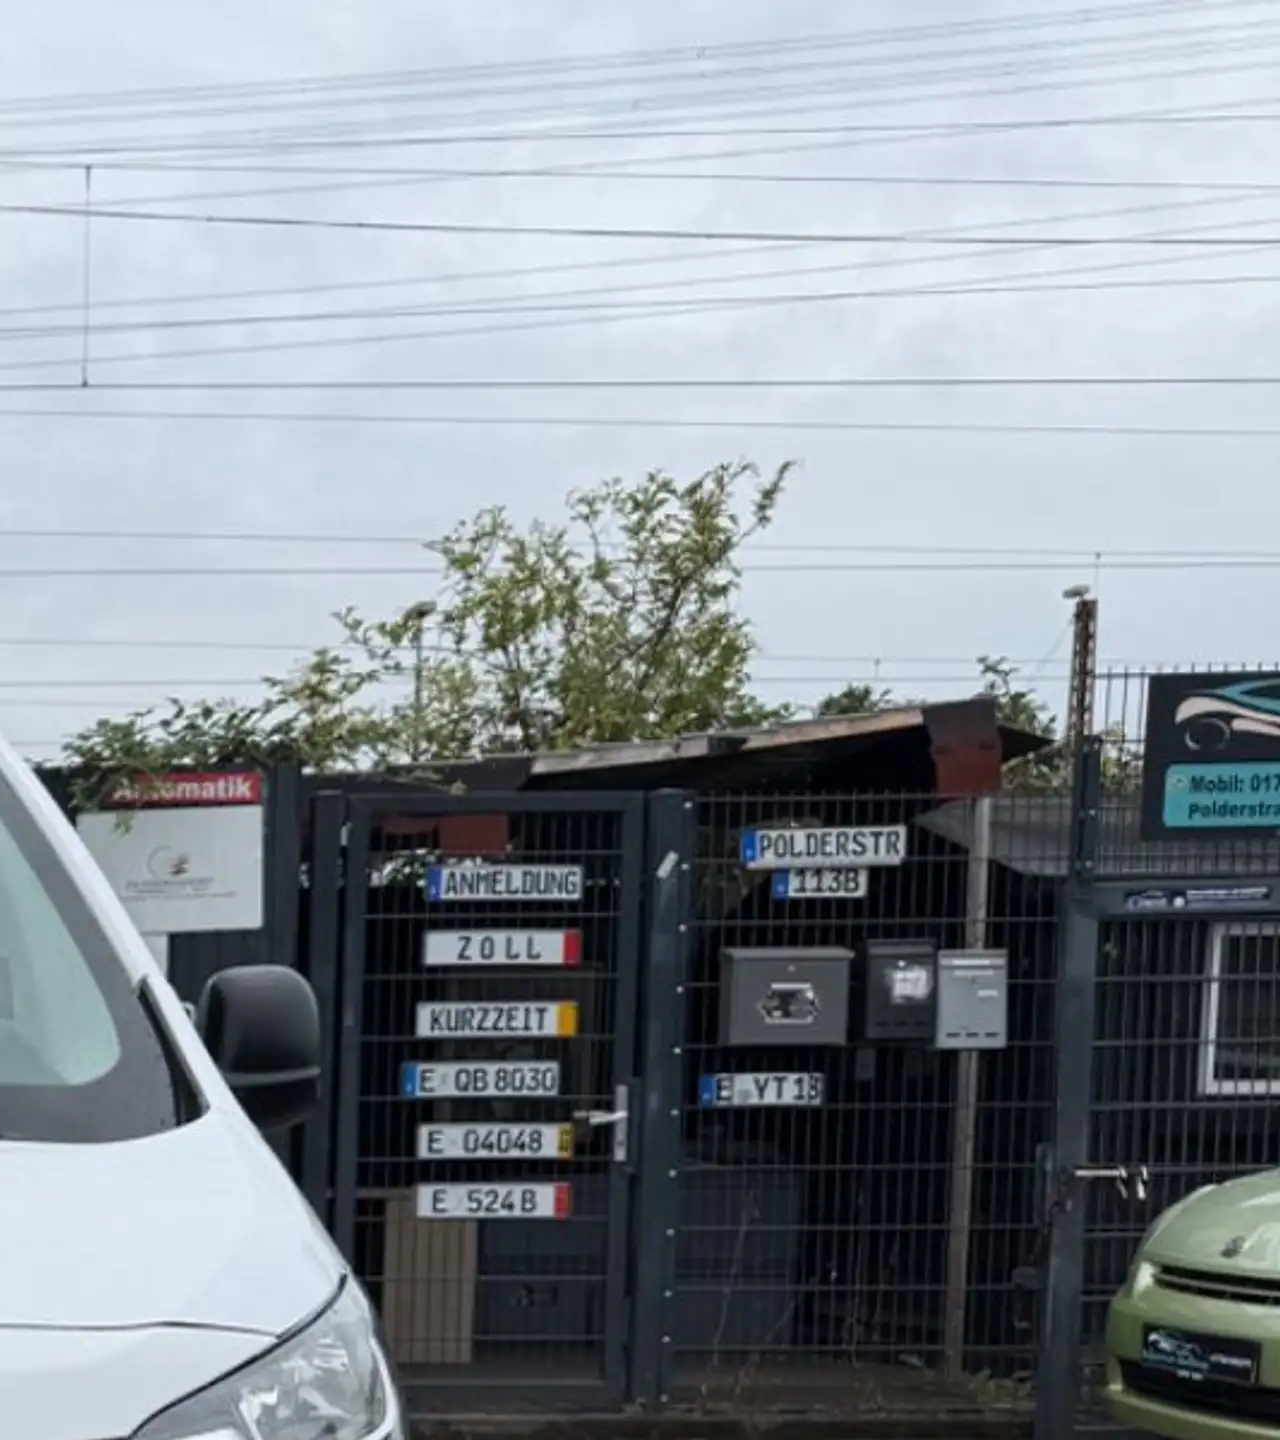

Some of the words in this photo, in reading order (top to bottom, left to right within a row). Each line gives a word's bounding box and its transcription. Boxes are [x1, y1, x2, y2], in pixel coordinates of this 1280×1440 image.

[758, 830, 901, 859] POLDERSTR
[444, 870, 578, 895] ANMELDUNG
[794, 869, 859, 893] 113B
[457, 936, 542, 961] ZOLL
[430, 1006, 549, 1032] KURZZEIT
[420, 1068, 436, 1092] E
[494, 1067, 556, 1092] 8030
[427, 1130, 444, 1154] E
[463, 1129, 542, 1153] 04048
[432, 1189, 448, 1213] E
